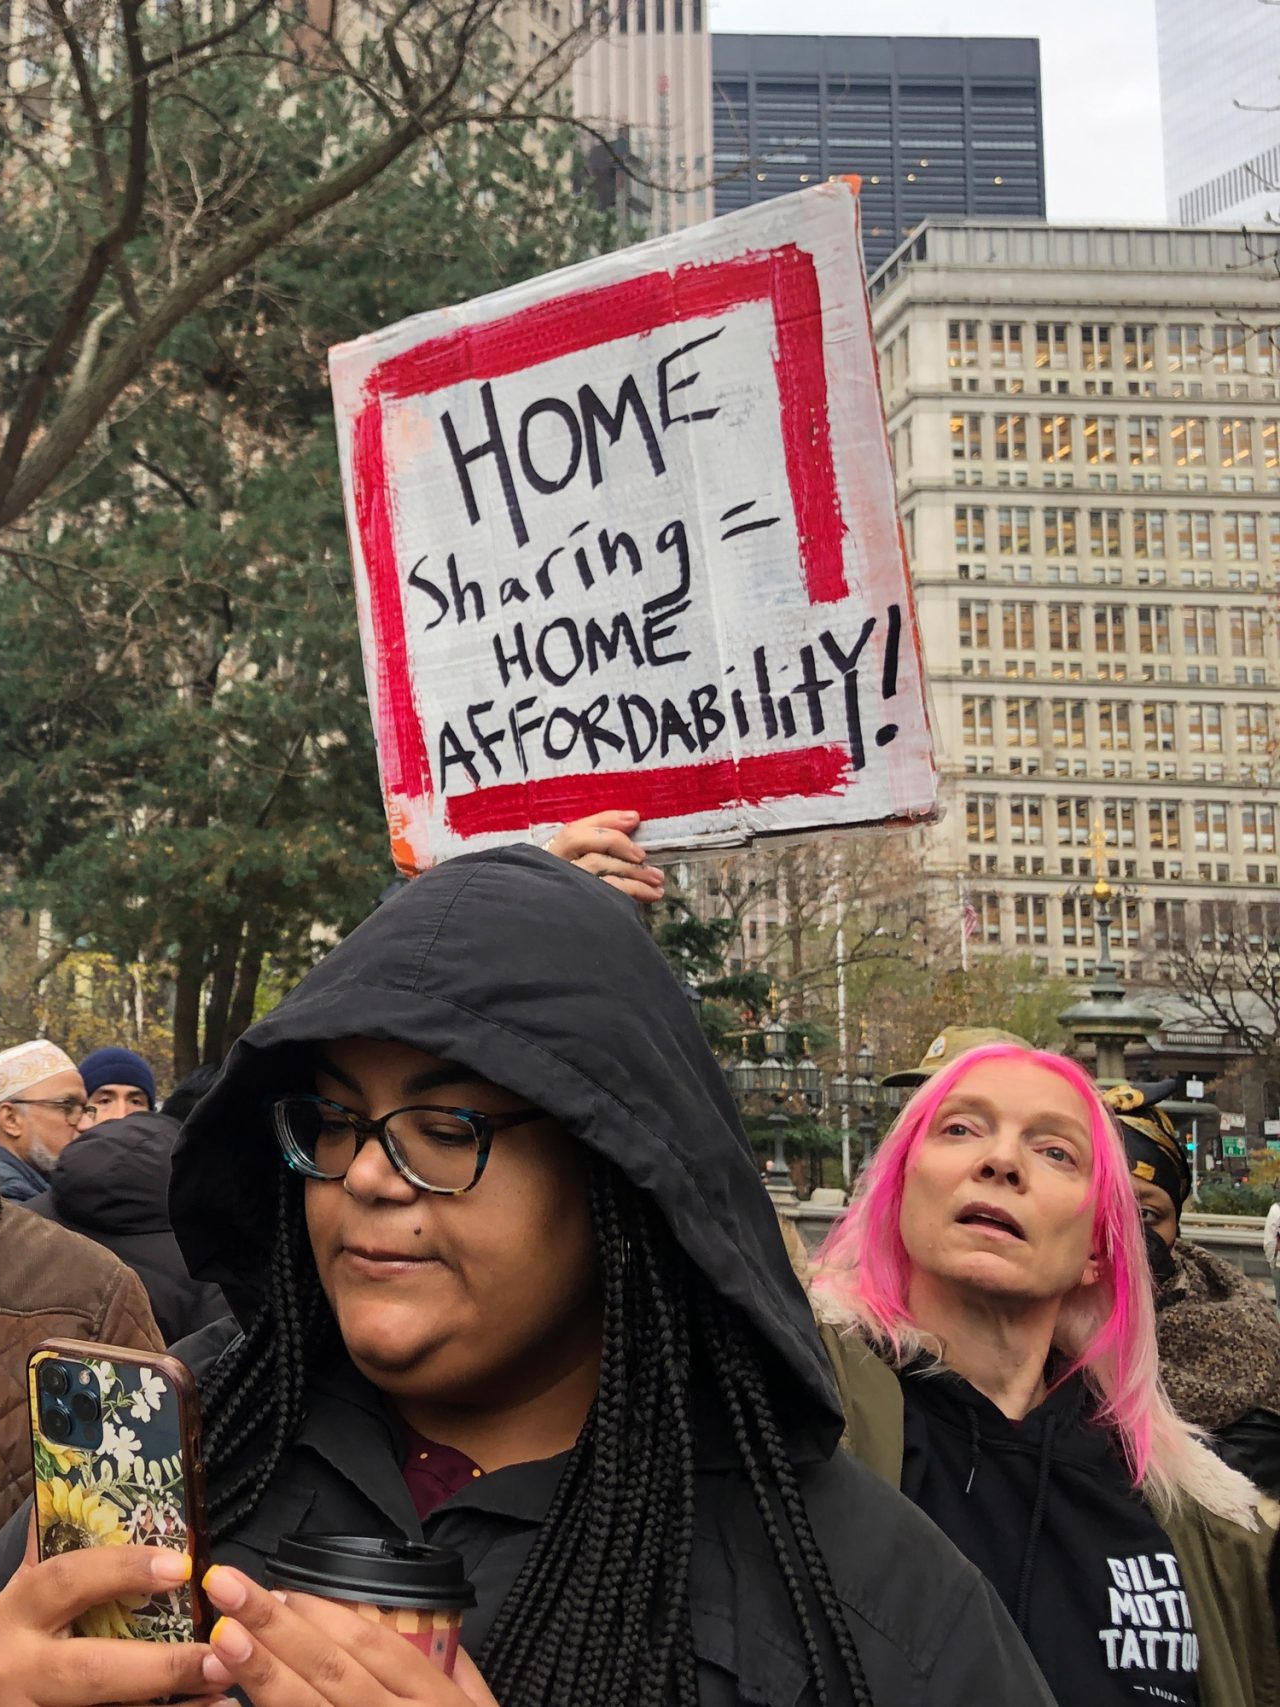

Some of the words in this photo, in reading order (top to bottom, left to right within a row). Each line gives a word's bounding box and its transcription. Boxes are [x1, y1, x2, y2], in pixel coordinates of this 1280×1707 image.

[440, 327, 725, 548] HOME
[408, 519, 691, 629] Sharing
[492, 595, 693, 688] HOME
[1106, 1553, 1180, 1592] GILT
